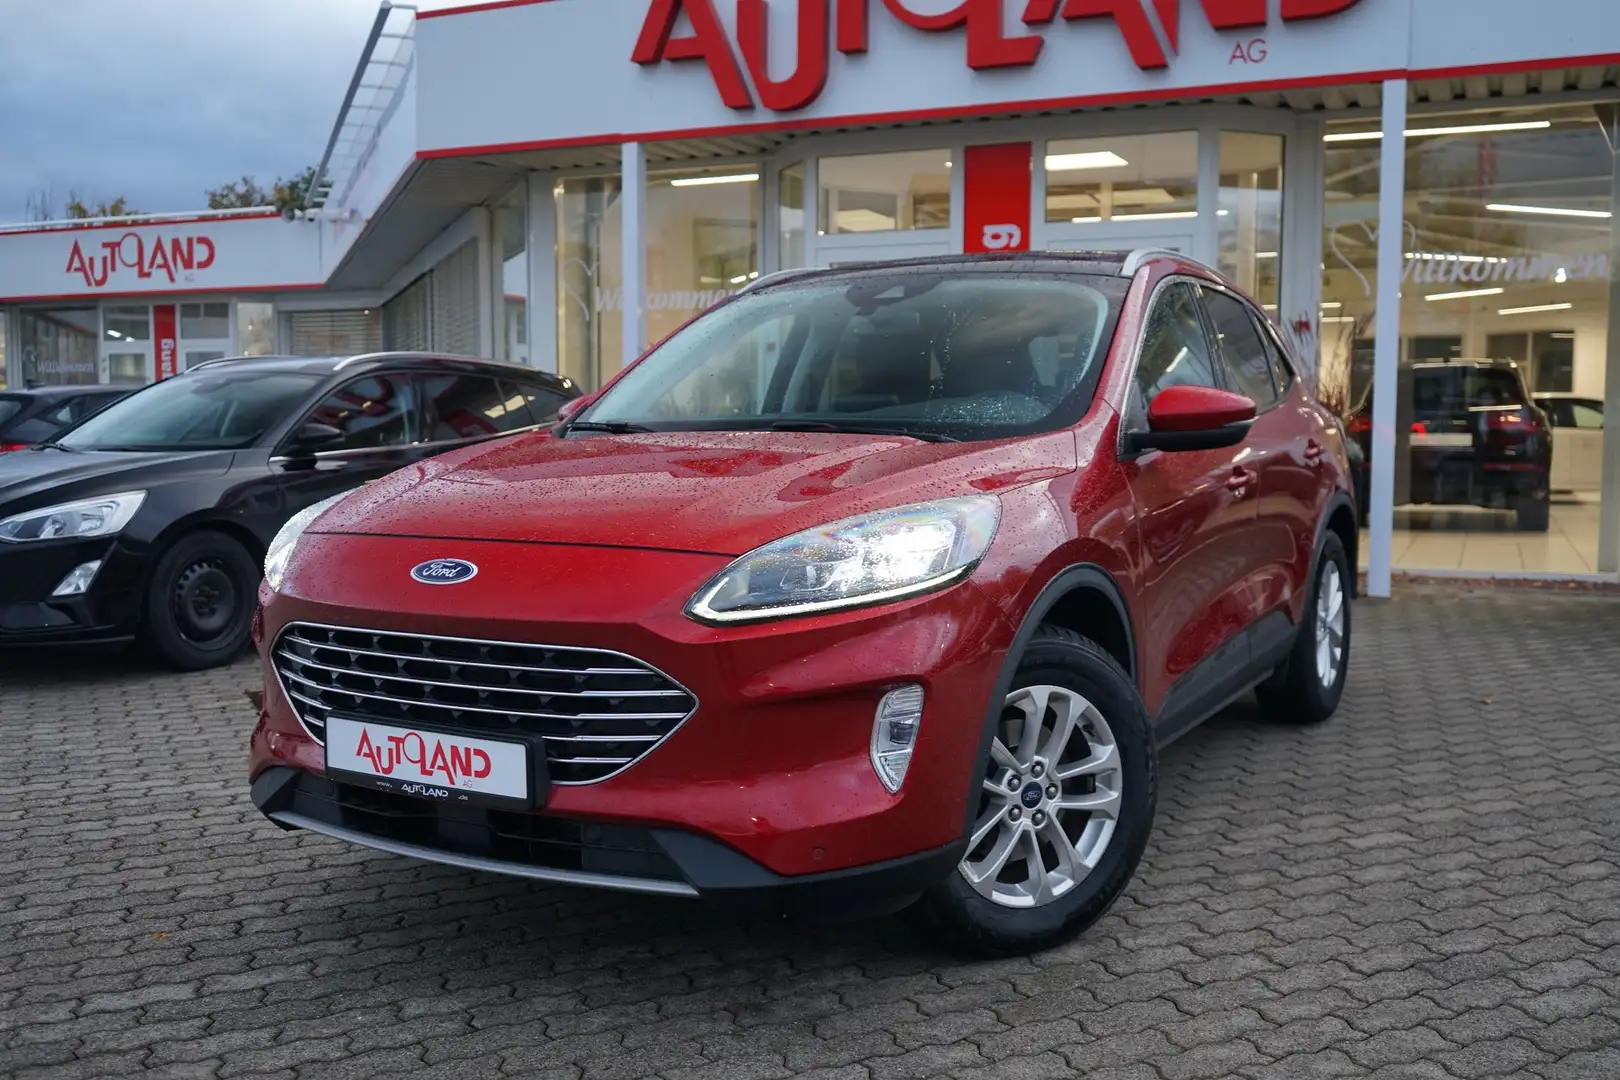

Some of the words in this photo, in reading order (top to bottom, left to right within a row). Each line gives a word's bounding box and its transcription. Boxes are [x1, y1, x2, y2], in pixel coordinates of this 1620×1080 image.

[1229, 38, 1268, 65] AG
[422, 561, 462, 578] Ford
[463, 780, 473, 789] AG
